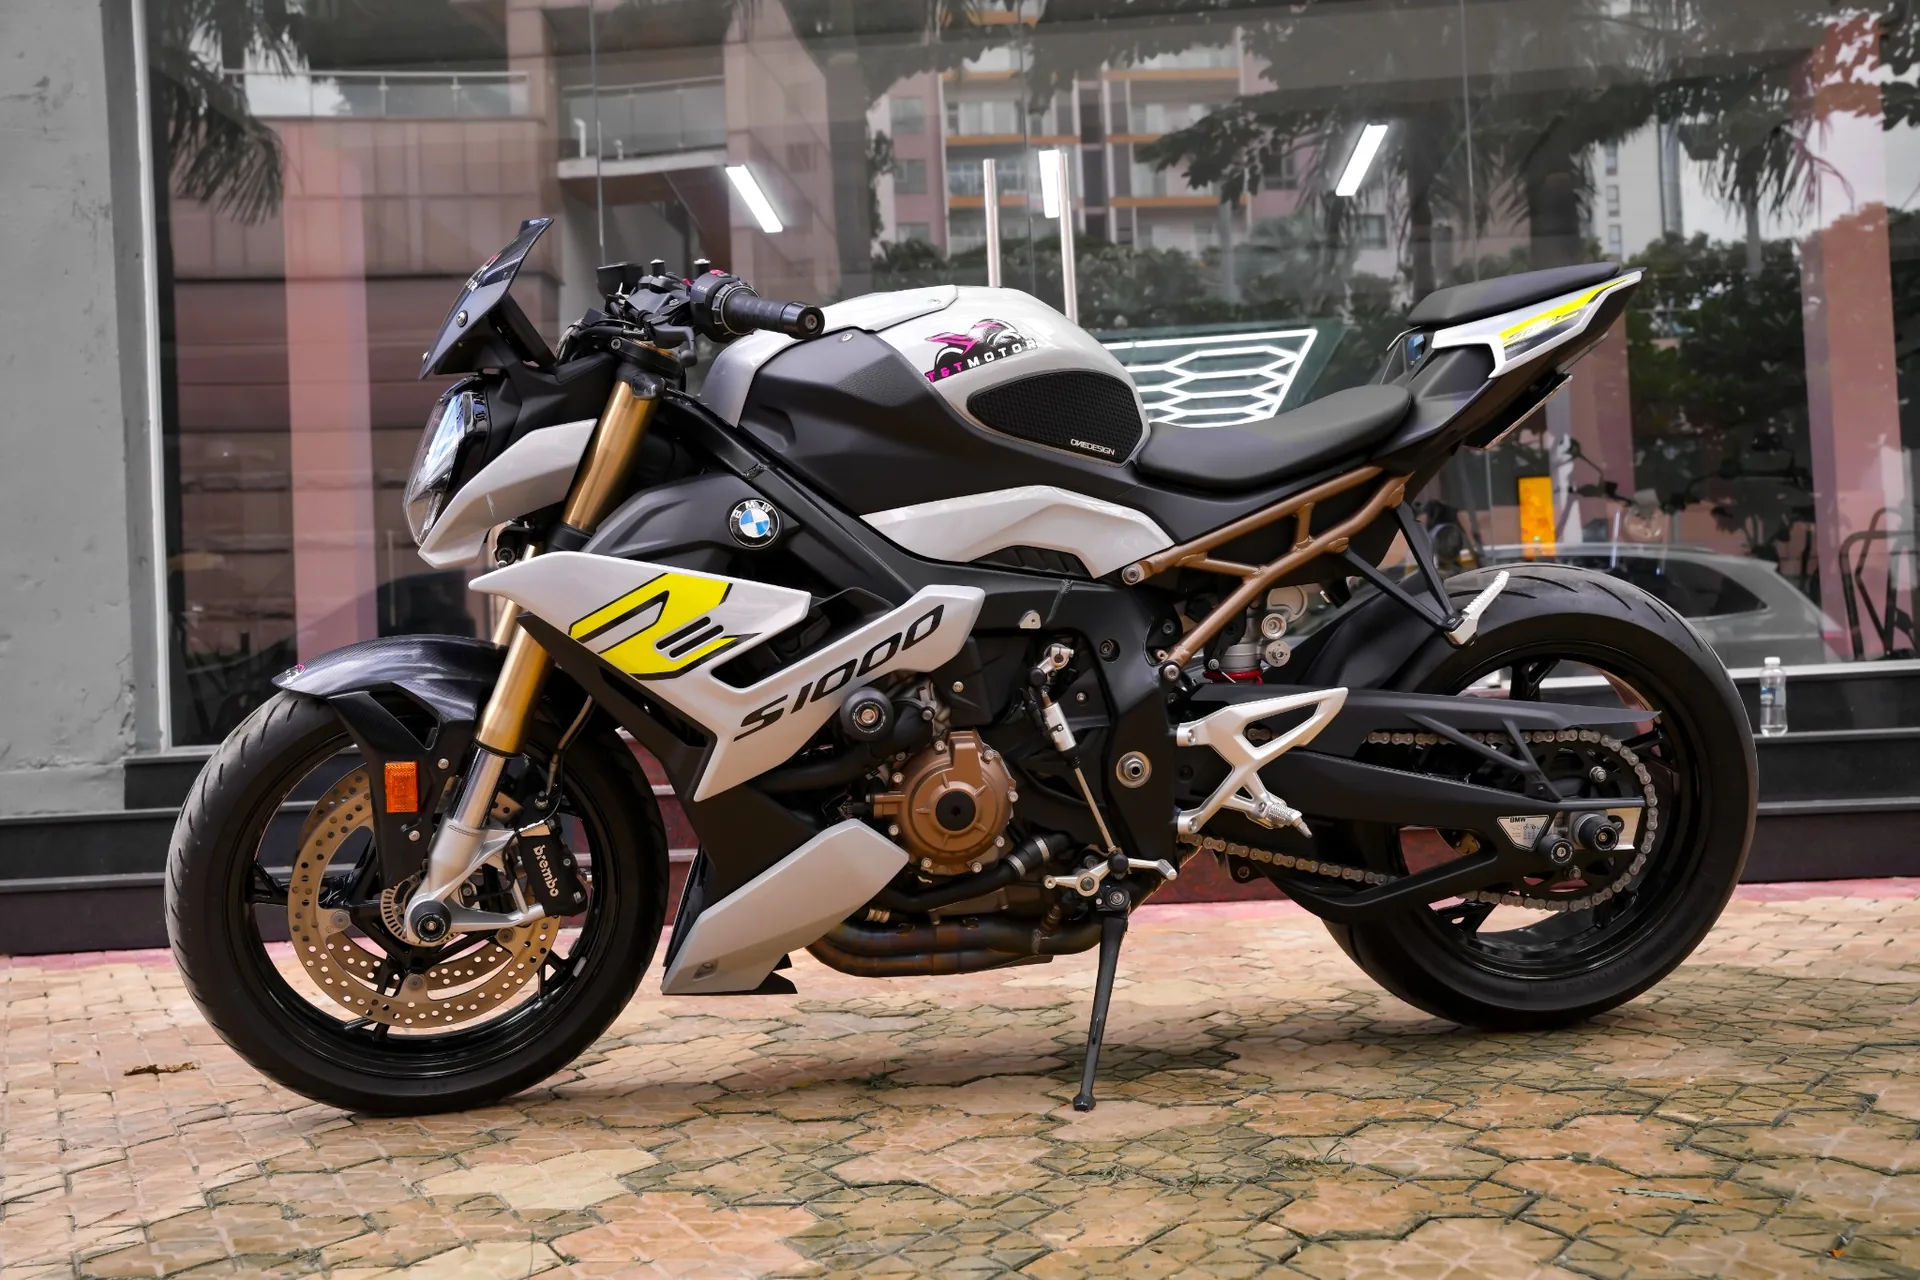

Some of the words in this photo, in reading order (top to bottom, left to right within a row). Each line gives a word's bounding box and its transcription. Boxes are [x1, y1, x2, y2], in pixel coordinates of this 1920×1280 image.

[966, 338, 1038, 369] MOTOR
[1070, 438, 1115, 456] ONEDESIGN
[731, 500, 772, 519] BMW
[733, 604, 945, 742] S1000
[533, 844, 560, 897] brembo
